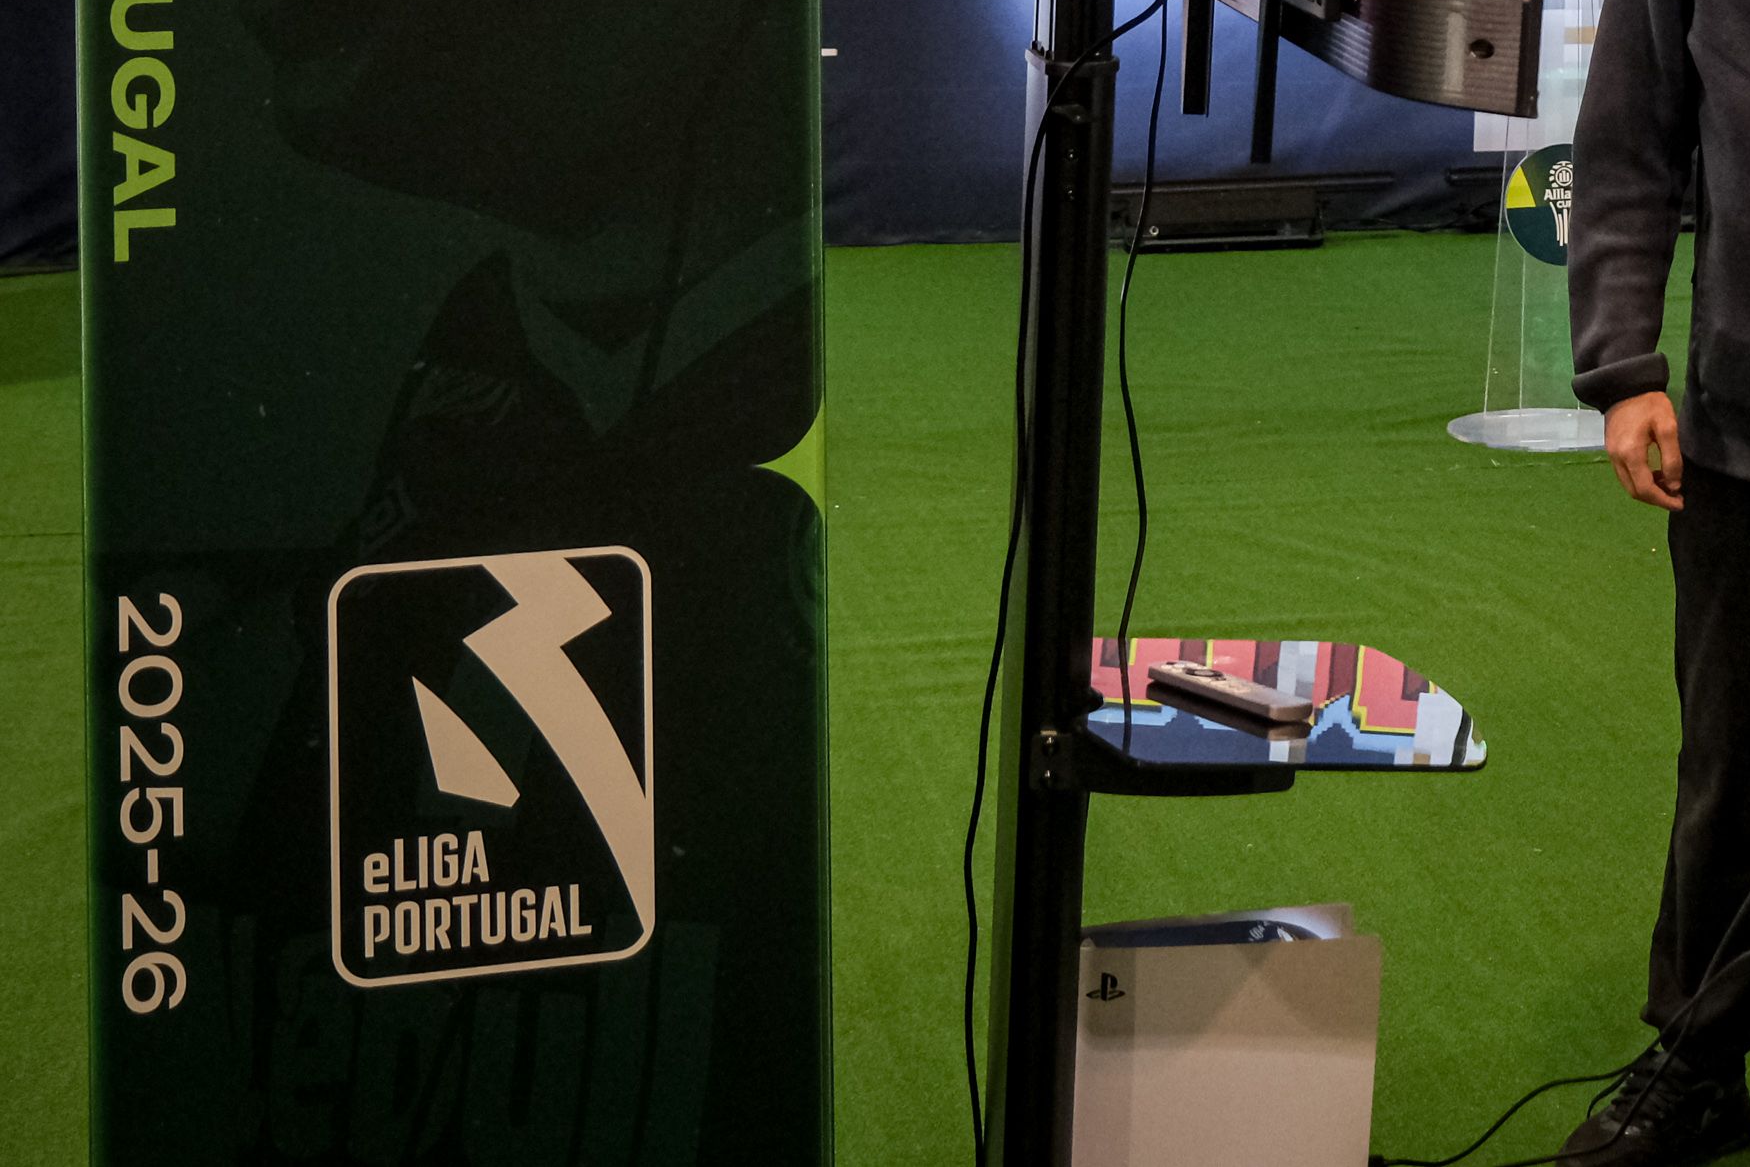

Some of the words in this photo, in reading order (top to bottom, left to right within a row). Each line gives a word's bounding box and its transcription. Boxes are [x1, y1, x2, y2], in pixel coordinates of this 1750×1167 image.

[1544, 189, 1571, 200] Allia
[118, 592, 187, 1014] 2025-26
[363, 830, 490, 895] eLIGA
[363, 884, 593, 959] PORTUGAL
